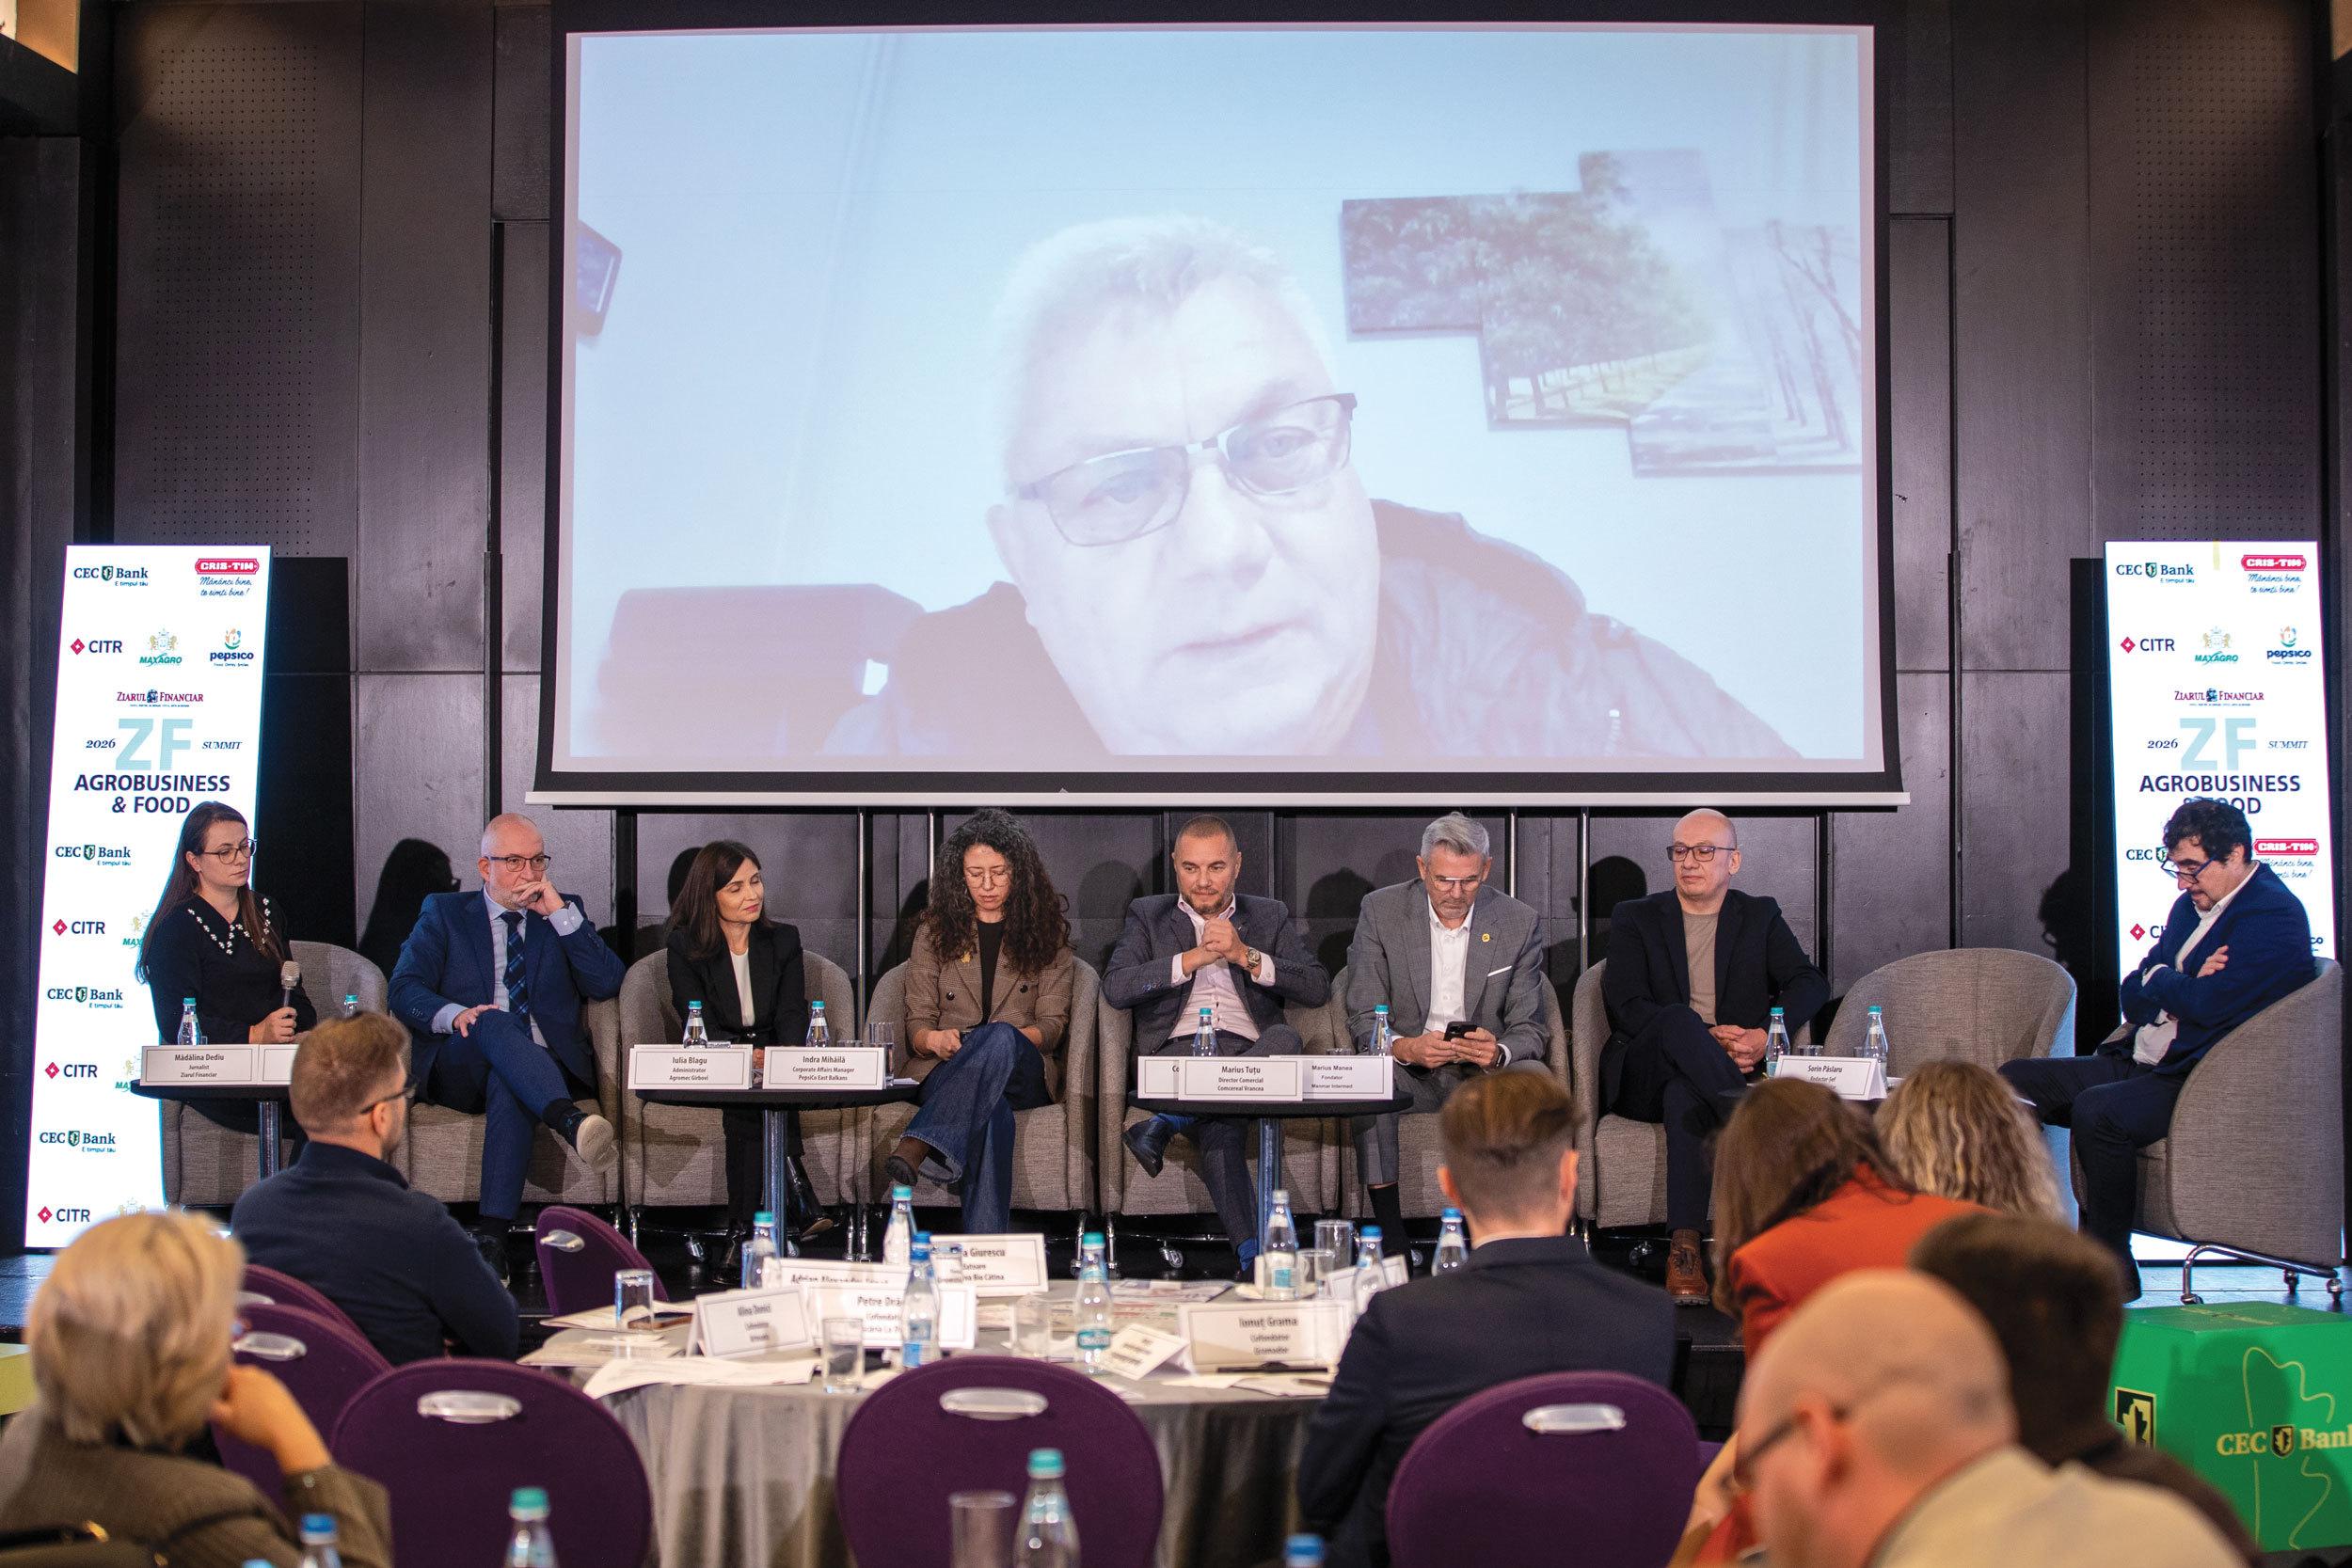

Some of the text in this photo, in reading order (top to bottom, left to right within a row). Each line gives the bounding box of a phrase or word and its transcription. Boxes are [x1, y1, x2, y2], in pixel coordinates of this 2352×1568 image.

[200, 562, 254, 571] CRIS-TIM
[2116, 563, 2194, 576] CEC Bank
[2246, 559, 2302, 567] CRIS-TIM
[73, 567, 149, 578] CEC Bank
[88, 640, 122, 654] CITR
[2139, 638, 2175, 652] CITR
[139, 653, 183, 666] MAXAGRO
[210, 652, 254, 661] pepsico
[2194, 651, 2239, 664] MAXAGRO
[2266, 650, 2312, 659] pepsico
[117, 691, 204, 702] ZIARUL FINANCIAR
[2174, 690, 2265, 701] ZIARUL FINANCIAR
[86, 718, 242, 771] 2026 ZF SUMMIT
[2147, 718, 2309, 771] 2026 ZF SUMMIT
[73, 774, 230, 792] AGROBUSINESS
[2139, 775, 2301, 792] AGROBUSINESS
[112, 796, 190, 814] & FOOD
[55, 847, 131, 858] CEC Bank
[2126, 848, 2153, 861] CEC
[71, 921, 105, 935] CITR
[47, 988, 123, 1001] CEC Bank
[688, 1056, 707, 1066] Blagu
[63, 1064, 98, 1078] CITR
[40, 1132, 116, 1145] CEC Bank
[56, 1209, 91, 1223] CITR
[970, 1247, 1006, 1258] Giurescu
[2217, 1431, 2267, 1456] CEC
